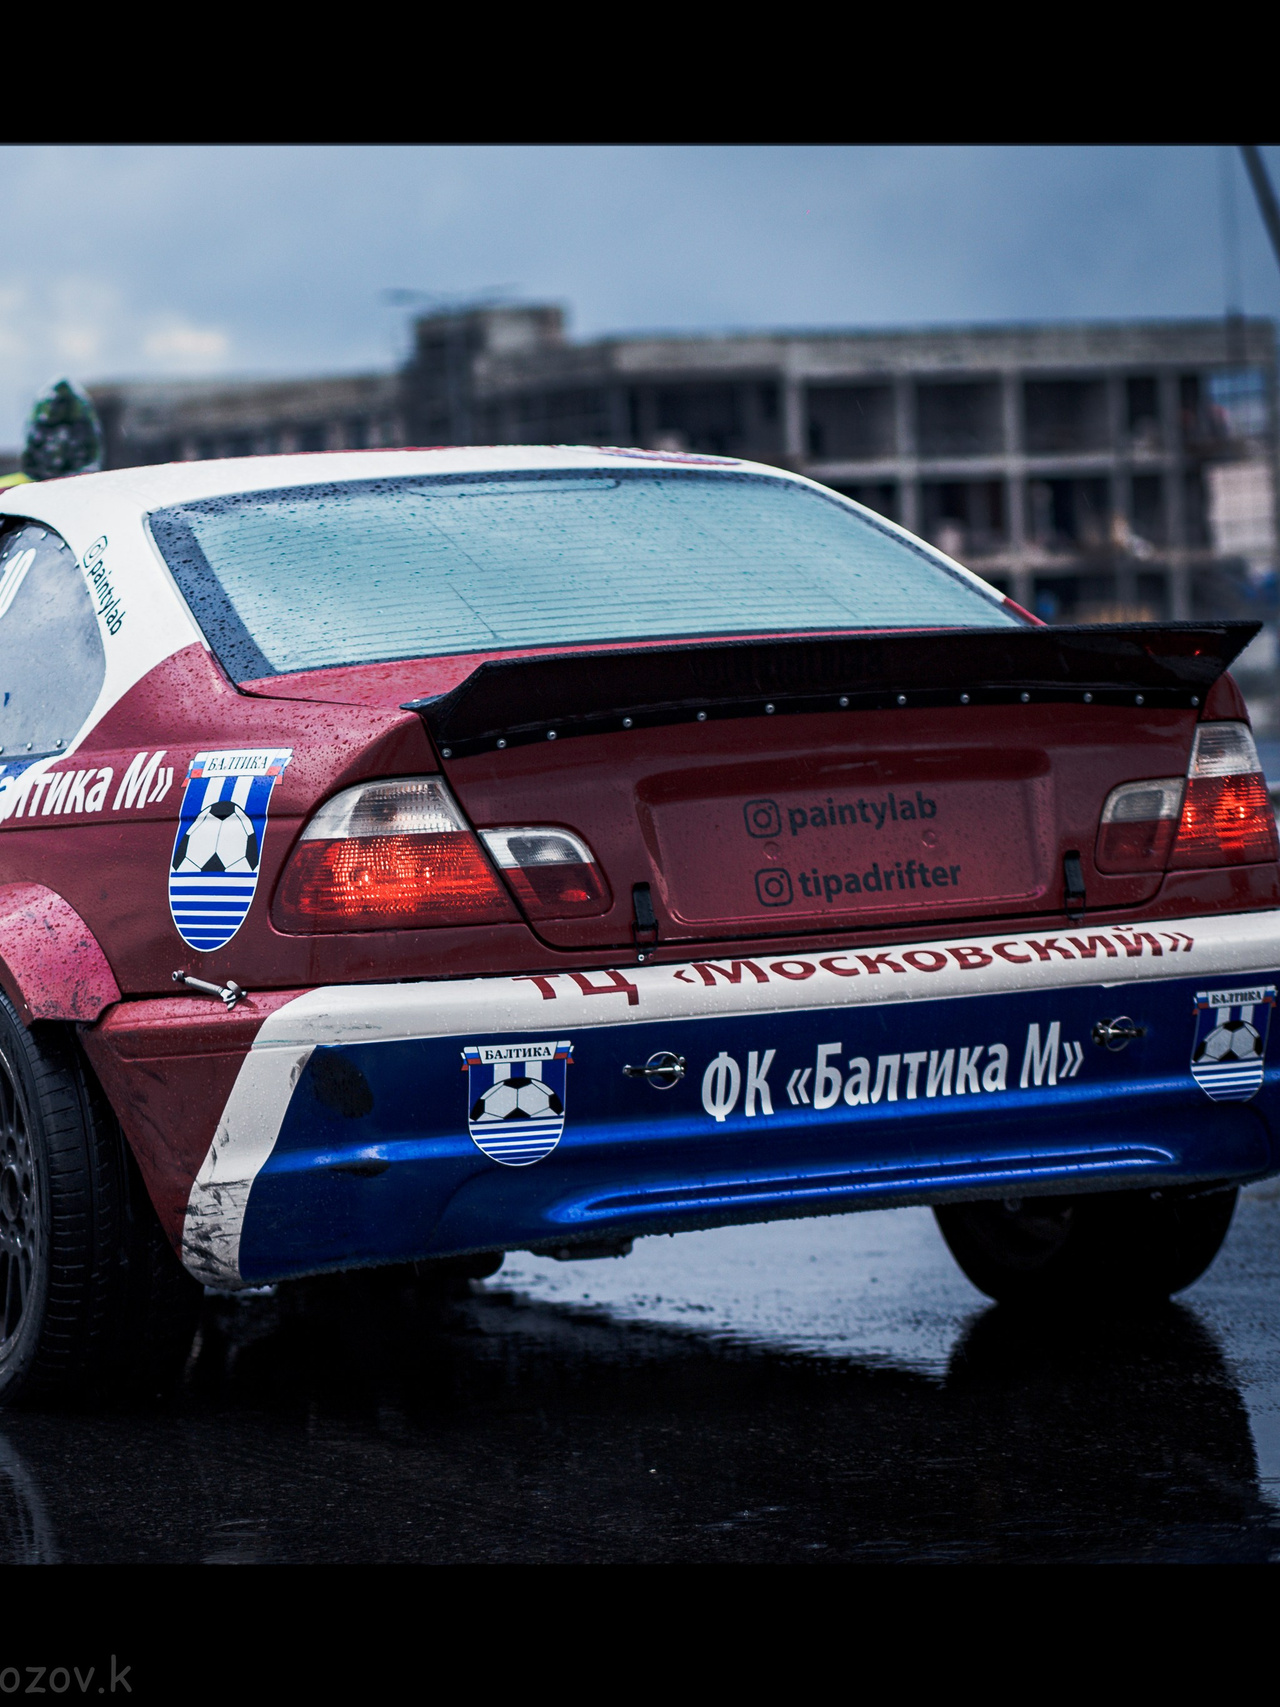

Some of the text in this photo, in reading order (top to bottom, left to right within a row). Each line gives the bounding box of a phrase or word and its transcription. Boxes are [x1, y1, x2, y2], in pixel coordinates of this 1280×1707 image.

[86, 559, 126, 636] paintylab
[112, 750, 175, 811] М»
[207, 755, 269, 772] БАЛТИКА
[787, 791, 938, 837] paintylab
[798, 859, 962, 903] tipadrifter
[512, 969, 640, 1006] ТЦ
[484, 1046, 552, 1060] БАЛТИКА
[700, 1021, 1085, 1122] ФК «Балтика М»
